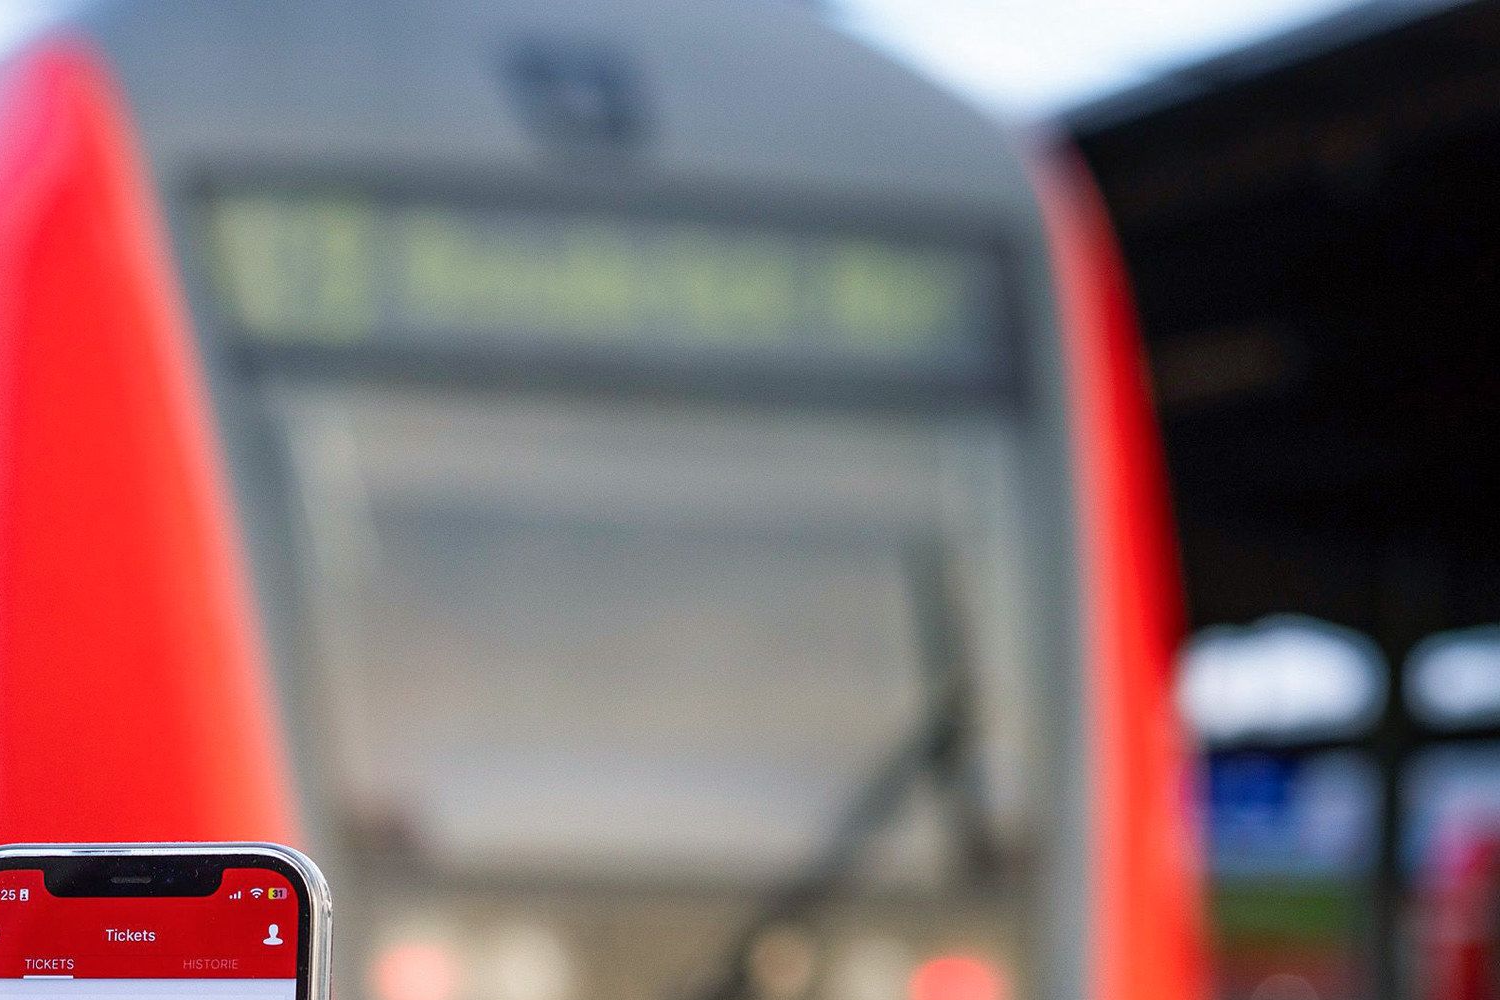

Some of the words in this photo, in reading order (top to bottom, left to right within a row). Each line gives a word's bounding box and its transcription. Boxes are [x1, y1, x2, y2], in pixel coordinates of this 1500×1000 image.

[272, 889, 283, 898] 31
[105, 929, 156, 942] Tickets
[24, 959, 74, 970] TICKETS
[183, 959, 239, 970] HISTORIE
